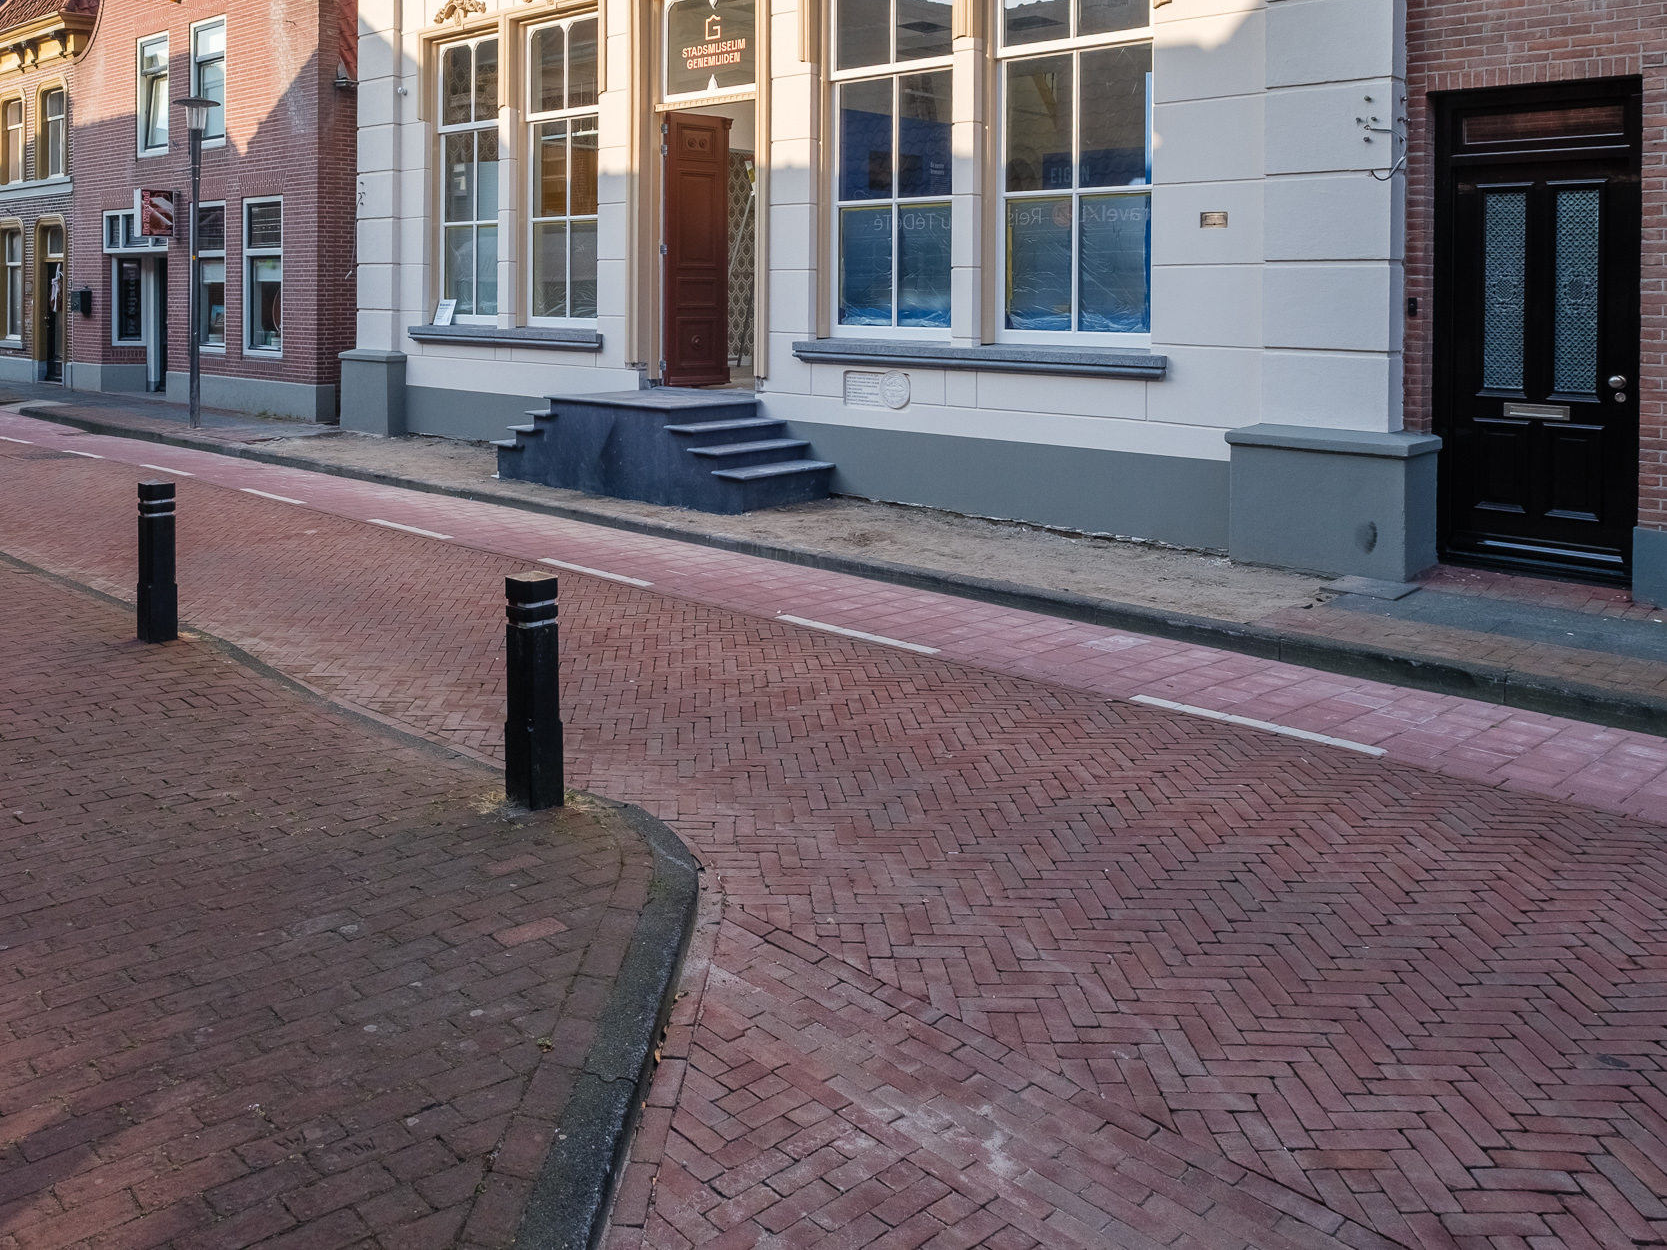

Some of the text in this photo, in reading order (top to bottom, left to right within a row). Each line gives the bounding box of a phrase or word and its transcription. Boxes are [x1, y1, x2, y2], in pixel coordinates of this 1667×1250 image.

[682, 38, 746, 58] STADSMUSEUM
[686, 52, 741, 70] GENEMUIDEN
[1050, 165, 1090, 184] EIGN
[127, 269, 137, 314] Nijstad
